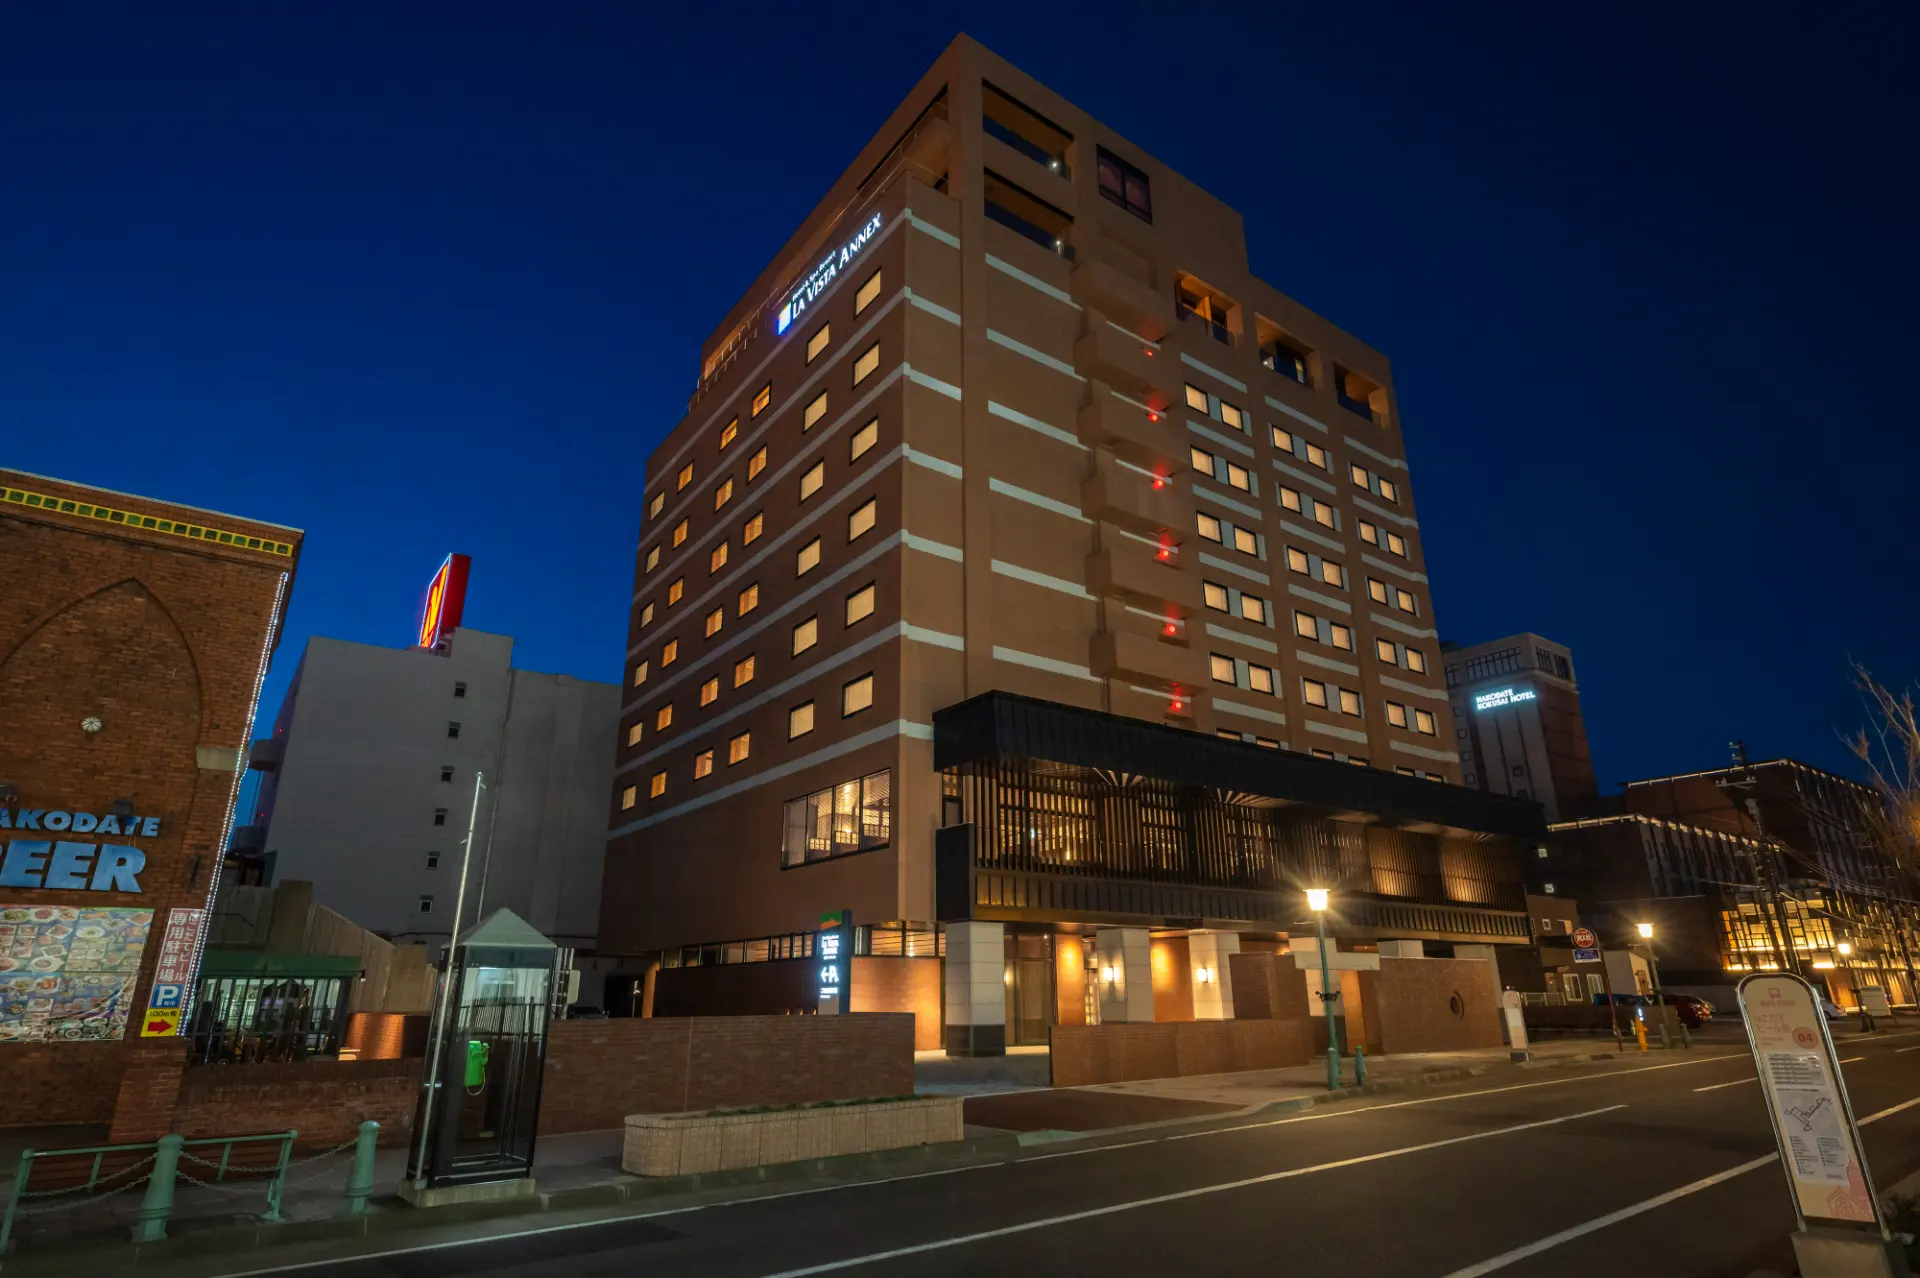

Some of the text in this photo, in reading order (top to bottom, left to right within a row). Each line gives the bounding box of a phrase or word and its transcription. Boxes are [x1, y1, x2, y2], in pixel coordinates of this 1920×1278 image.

[792, 212, 881, 320] LA VISTA ANNEX
[1510, 690, 1536, 703] HOTEL
[0, 839, 146, 893] EER
[158, 912, 188, 982] 専用駐車場
[156, 985, 179, 1006] P
[1798, 1032, 1813, 1043] 04
